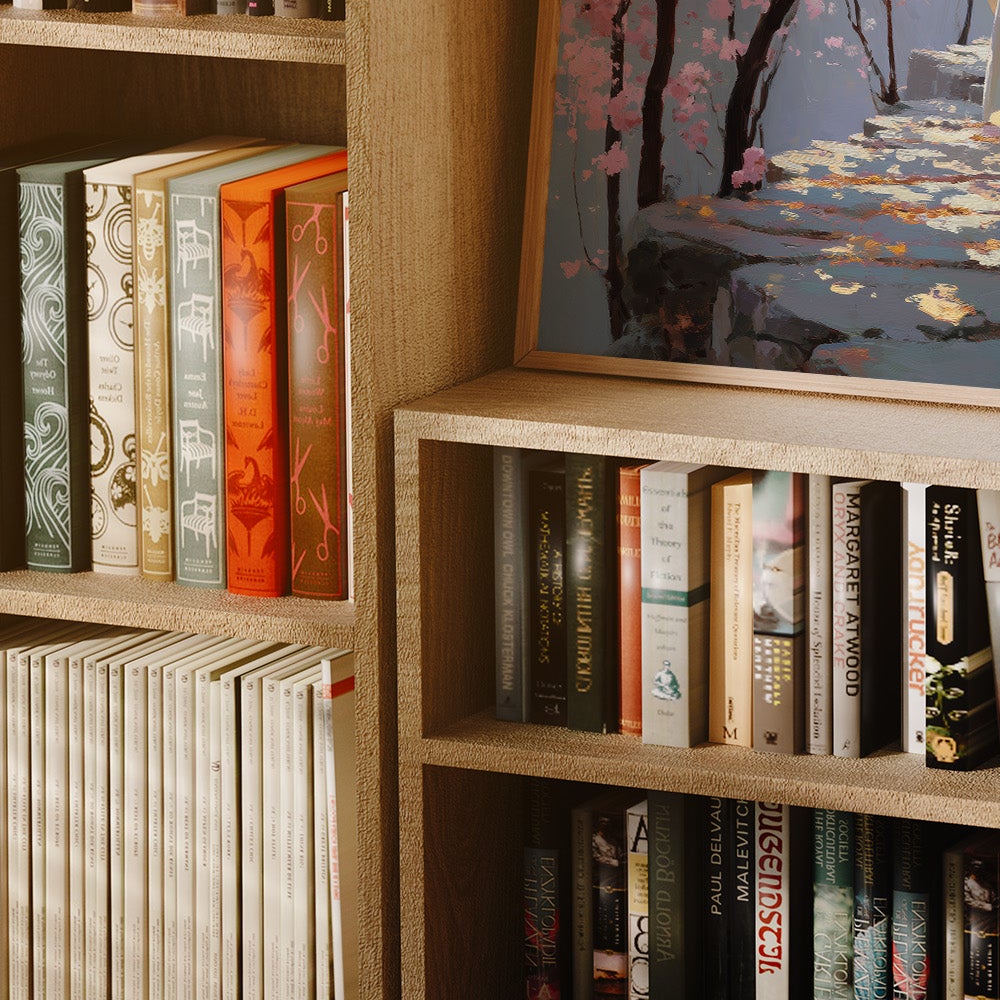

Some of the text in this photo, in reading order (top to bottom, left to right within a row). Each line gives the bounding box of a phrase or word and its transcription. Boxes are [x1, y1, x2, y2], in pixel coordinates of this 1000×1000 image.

[501, 455, 514, 691] DOWNTOWN OWL CHUCK KLOSTERMAN
[834, 492, 846, 669] ORYX AND CRAKE
[846, 492, 860, 697] MARGARET ATWOOD
[711, 797, 722, 916] PAUL DELVAU
